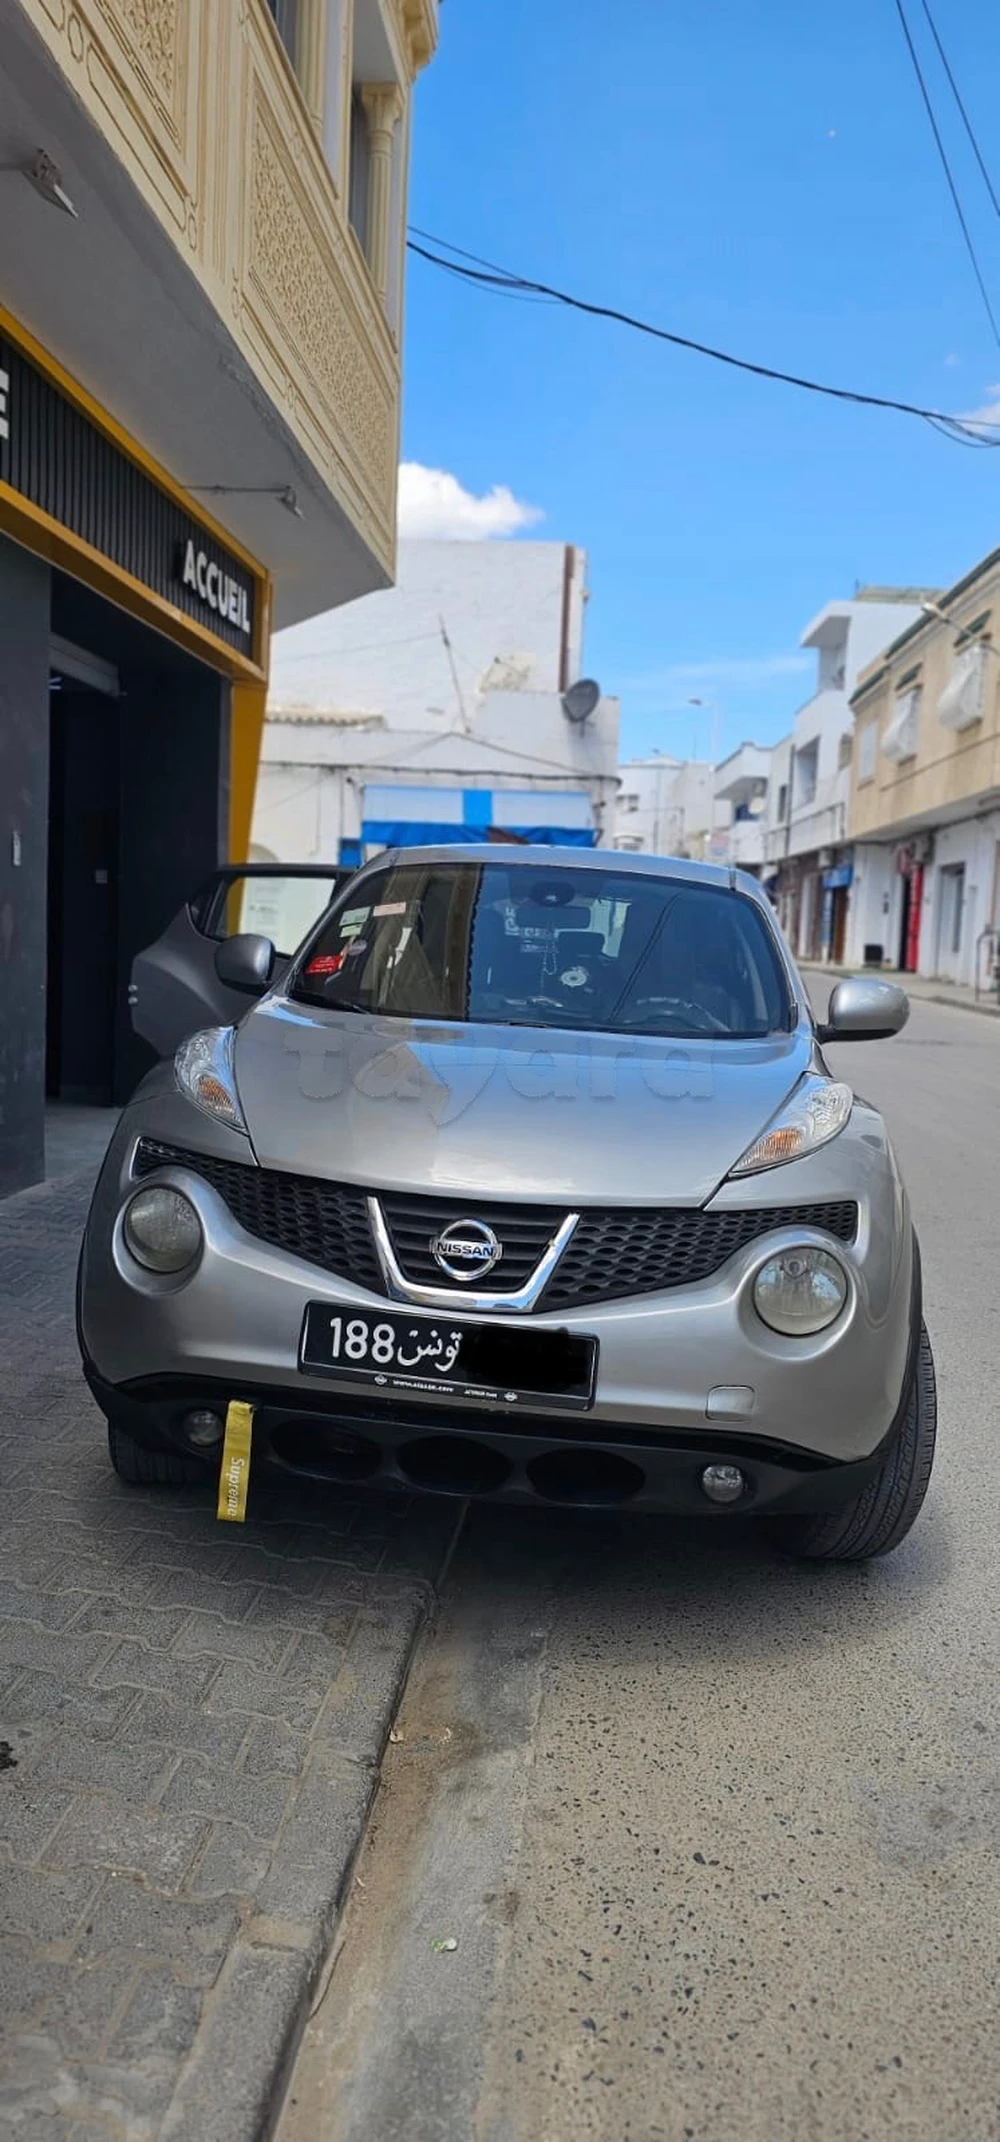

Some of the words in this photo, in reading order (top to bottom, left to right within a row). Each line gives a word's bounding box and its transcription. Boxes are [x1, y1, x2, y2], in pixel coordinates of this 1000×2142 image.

[183, 539, 250, 633] ACCUEIL
[437, 1242, 494, 1257] NISSAN
[330, 1317, 395, 1363] 188
[397, 1329, 463, 1371] تونس
[225, 1457, 245, 1517] Supreme
